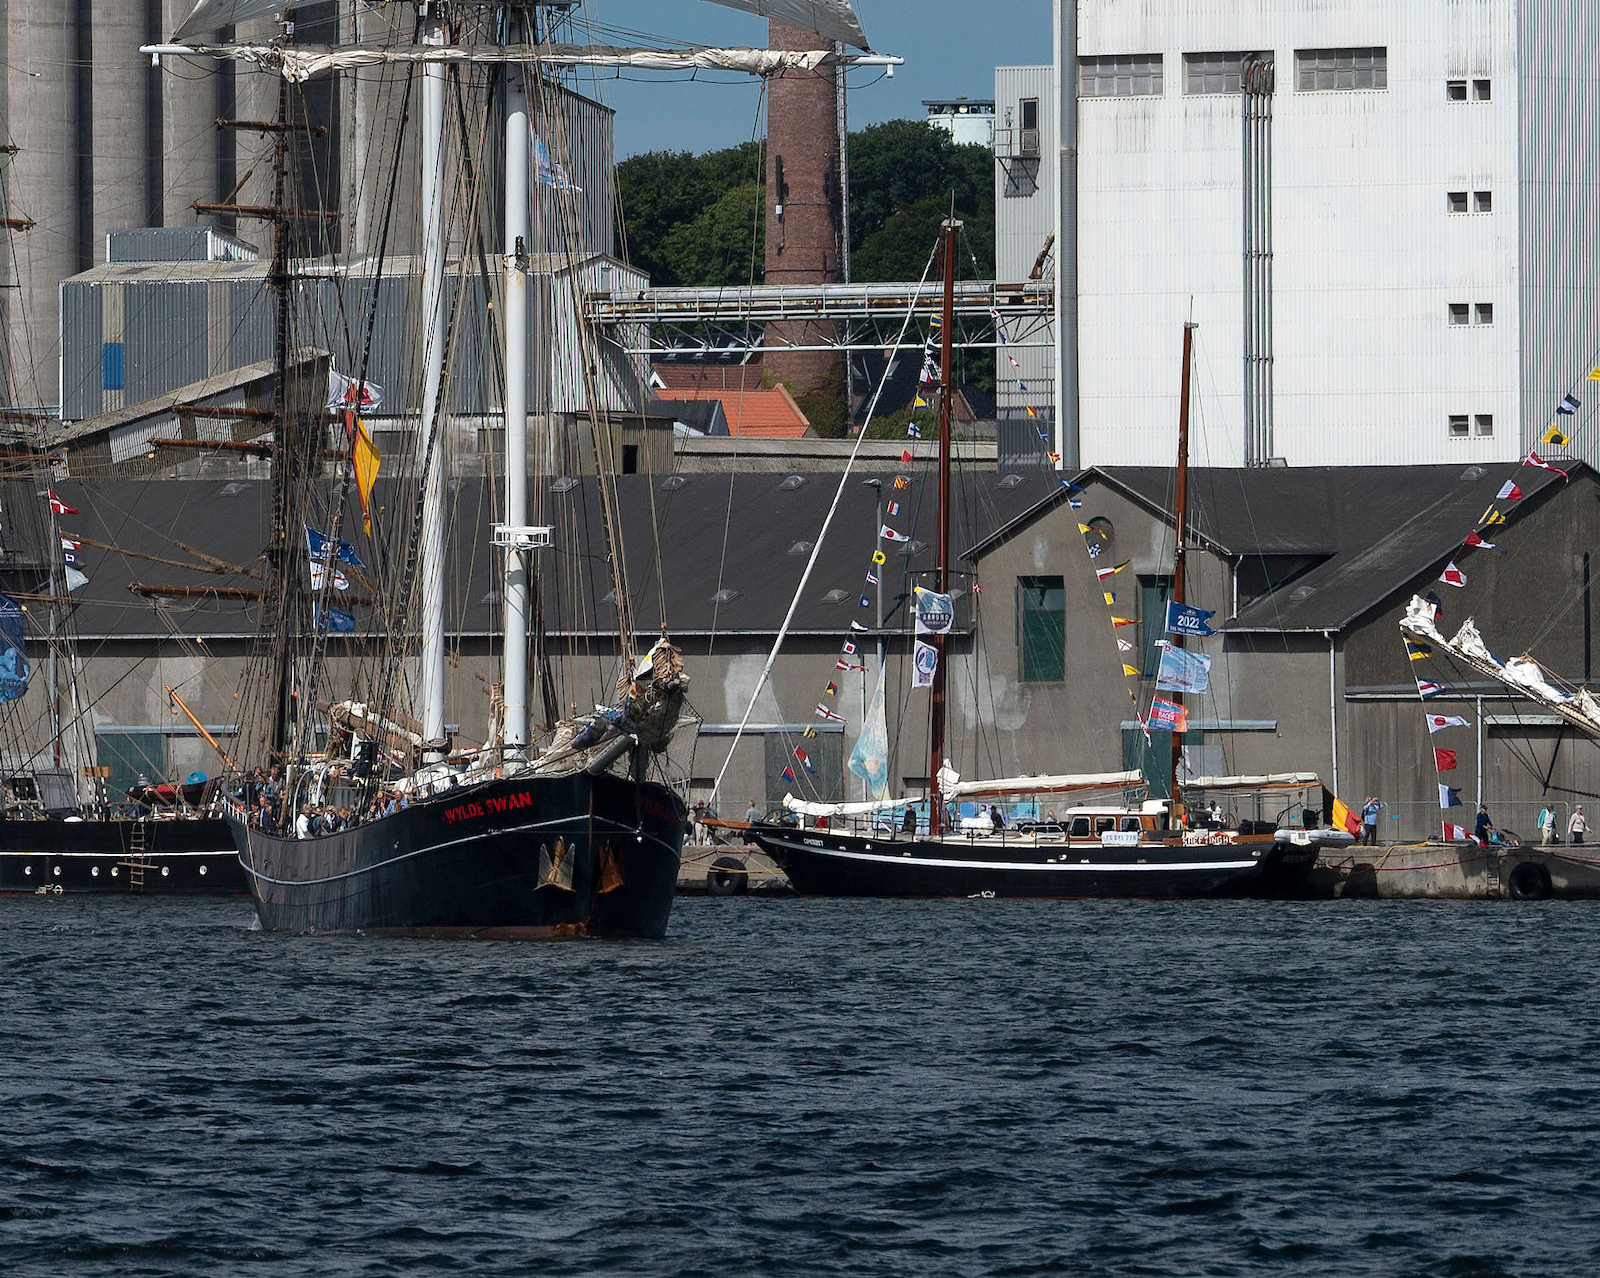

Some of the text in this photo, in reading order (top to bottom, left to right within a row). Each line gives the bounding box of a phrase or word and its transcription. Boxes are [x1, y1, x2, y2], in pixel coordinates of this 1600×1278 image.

[1177, 615, 1200, 629] 2022
[444, 791, 533, 824] WYLDE SWAN
